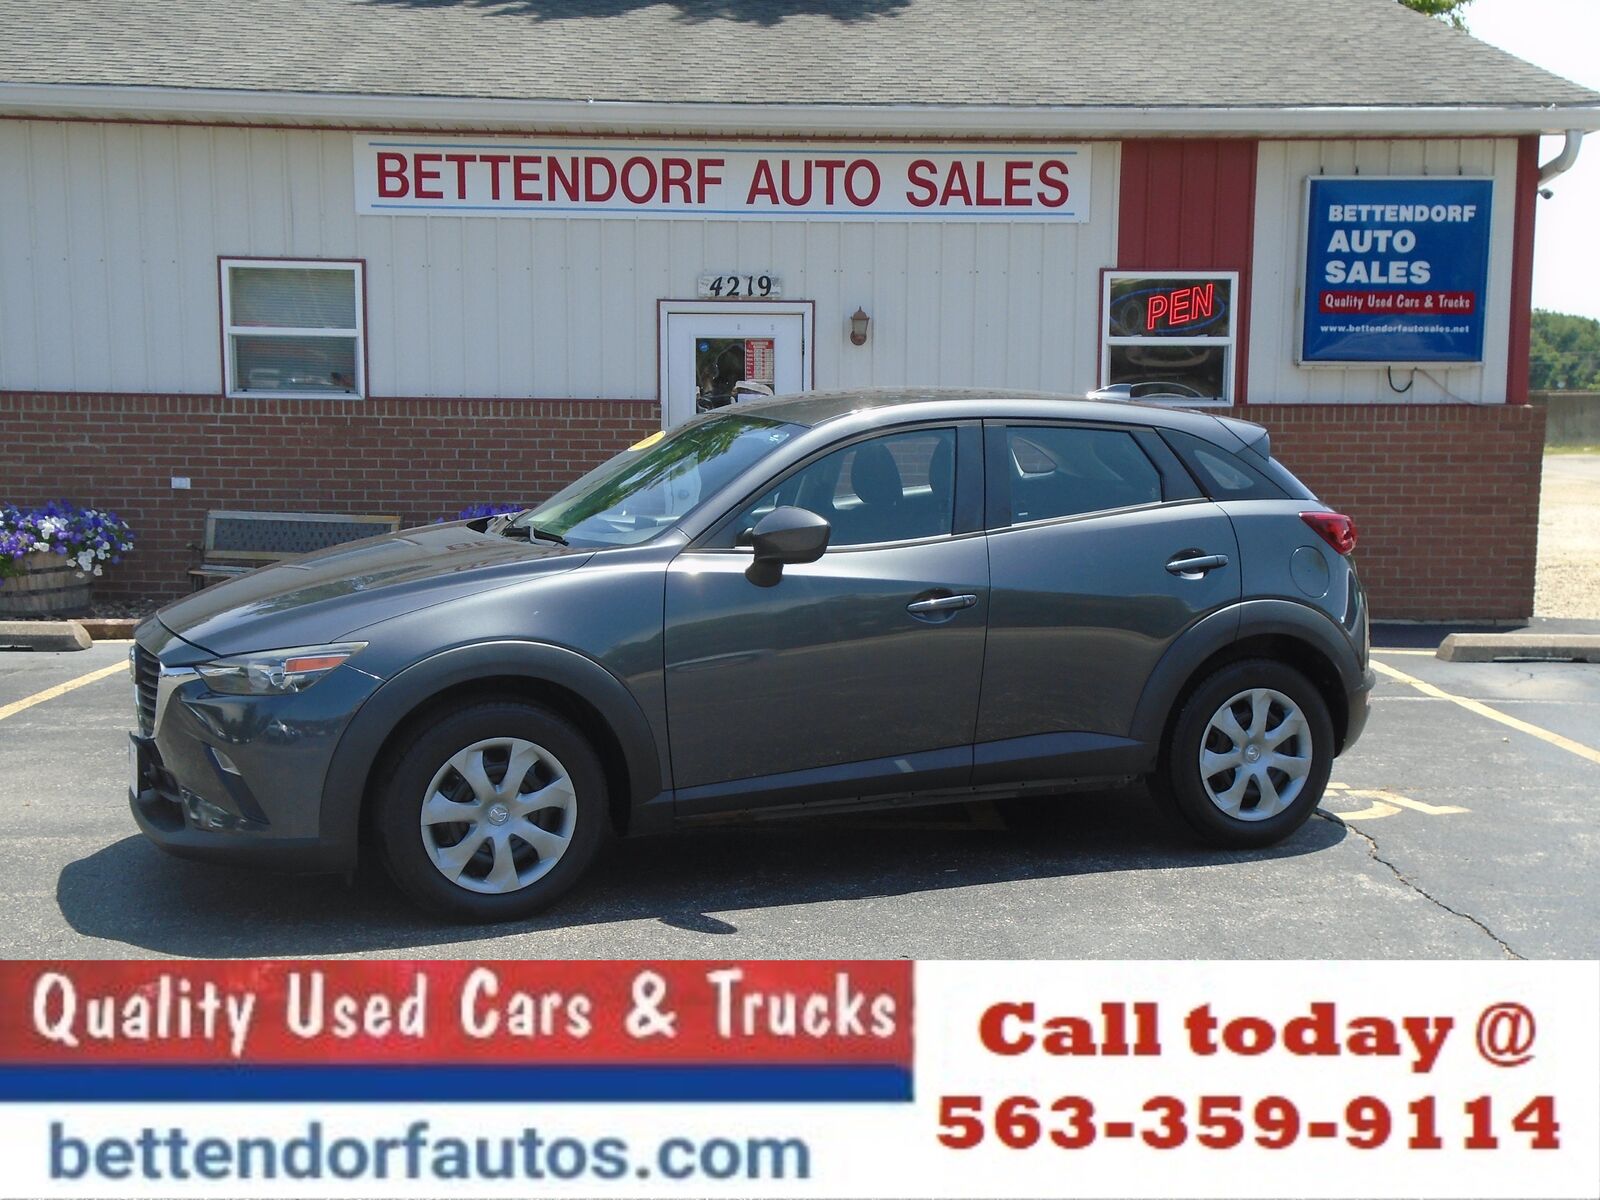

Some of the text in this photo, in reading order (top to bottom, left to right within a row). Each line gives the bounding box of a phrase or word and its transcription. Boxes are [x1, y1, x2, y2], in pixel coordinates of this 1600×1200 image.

[377, 152, 1069, 207] BETTENDORF AUTO SALES
[1328, 205, 1477, 222] BETTENDORF
[1327, 230, 1416, 253] AUTO
[1325, 260, 1431, 284] SALES
[709, 275, 772, 297] 4219
[1325, 294, 1471, 310] Quality Used Cars & Trucks
[1320, 324, 1470, 333] www.bettendorfautosales.net
